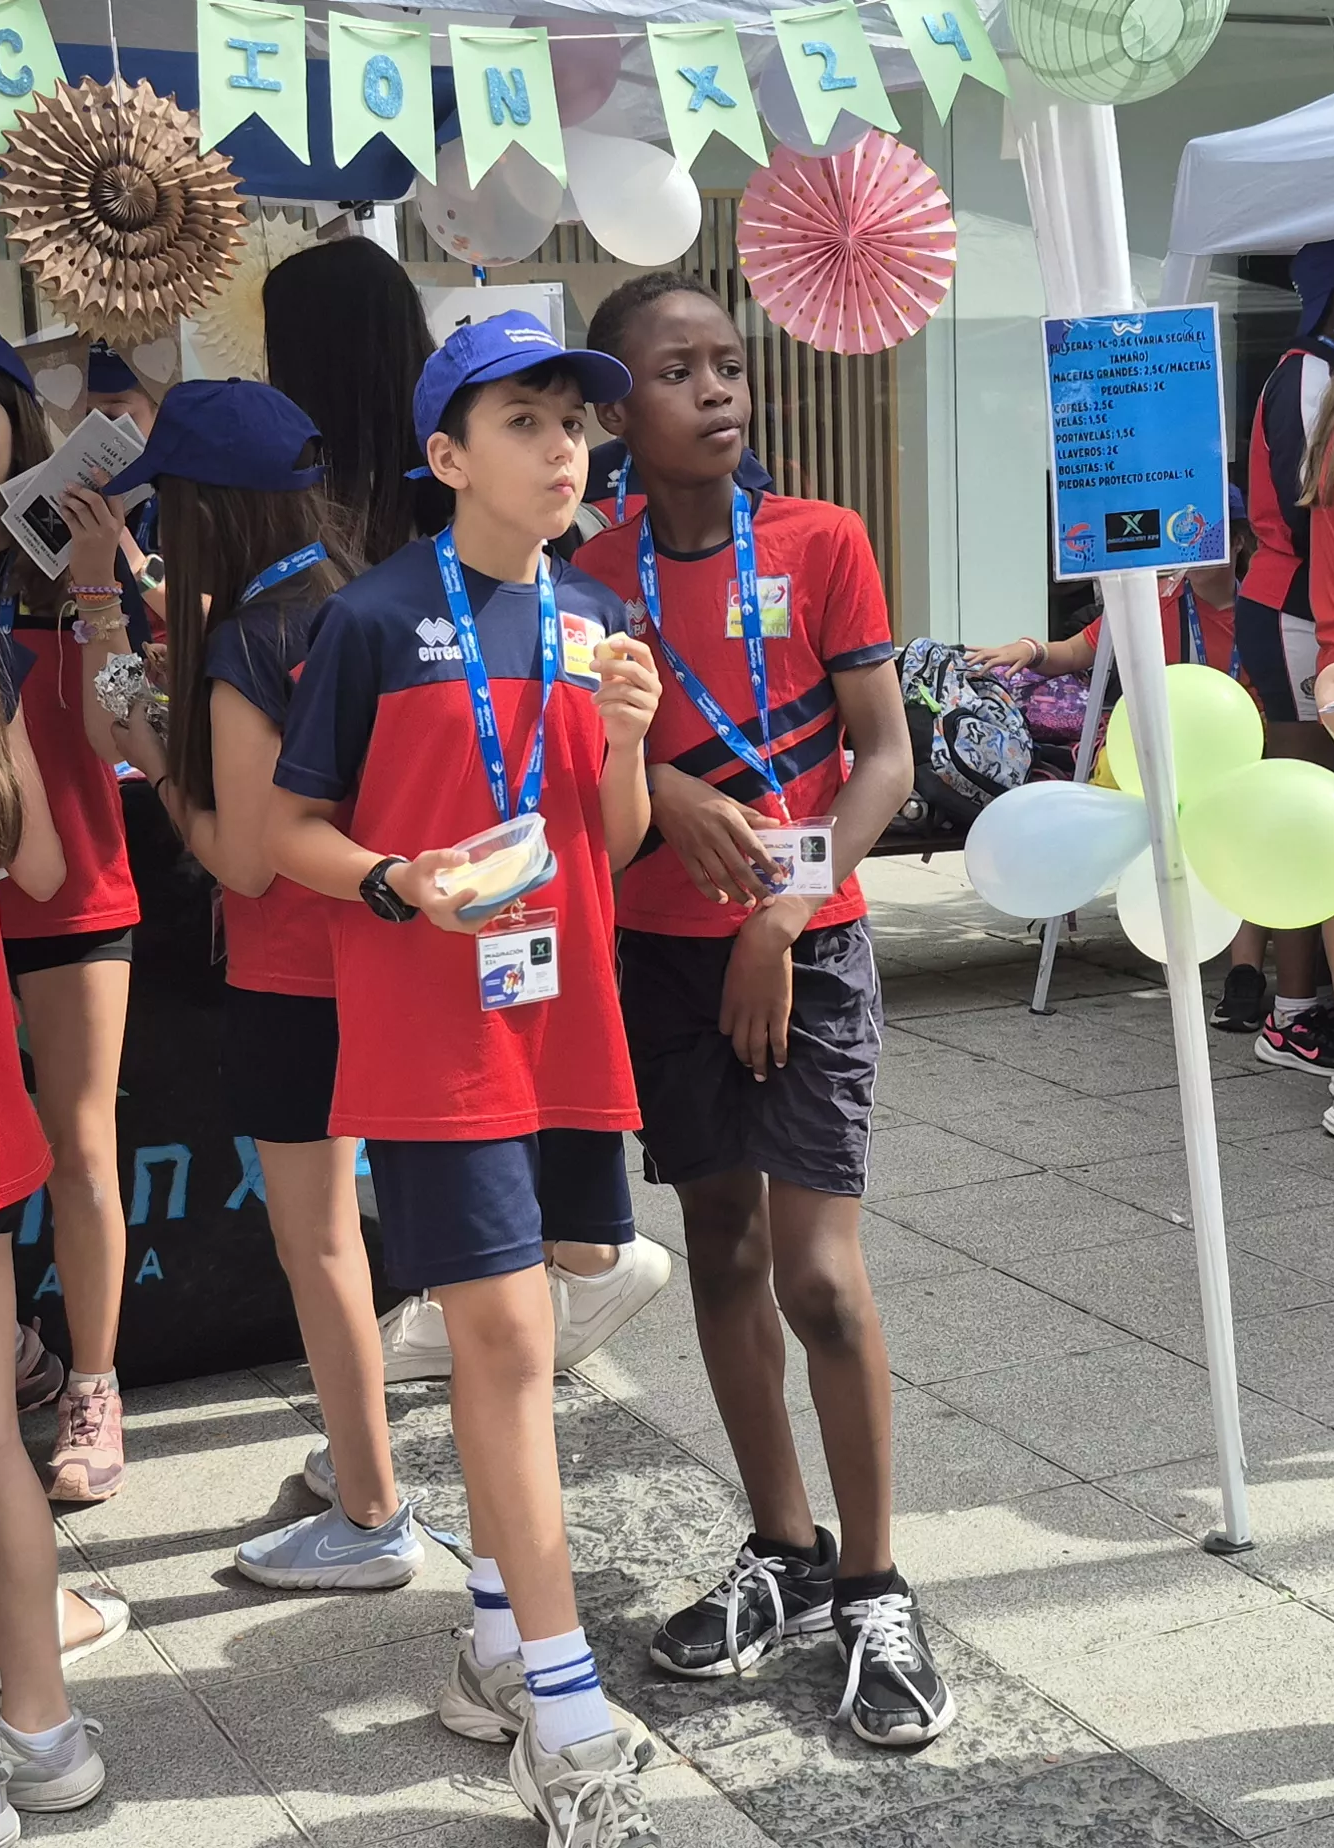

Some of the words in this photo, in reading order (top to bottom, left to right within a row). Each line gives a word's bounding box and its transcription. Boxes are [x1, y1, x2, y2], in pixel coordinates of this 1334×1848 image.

[1196, 331, 1206, 341] EL
[1110, 350, 1149, 364] TAMAÑO)
[1053, 371, 1094, 383] MACETAS
[1097, 368, 1143, 380] GRANDES:
[1101, 380, 1152, 396] PEQUEÑAS:
[1154, 381, 1166, 392] 2€
[1053, 402, 1093, 414] COFRES:
[1093, 400, 1114, 412] 2,5€
[1055, 416, 1087, 428] VELAS:
[1088, 414, 1108, 426] 1,5€
[1056, 430, 1115, 444] PORTAVELAS:
[1058, 447, 1105, 460] LLAVEROS:
[1107, 445, 1118, 455] 2€
[1059, 463, 1103, 476] BOLSITAS:
[1105, 461, 1115, 471] 1€
[1059, 477, 1096, 490] PIEDRAS
[1099, 473, 1143, 487] PROYECTO
[1146, 470, 1183, 483] ECOPAL:
[1185, 468, 1195, 479] 1€
